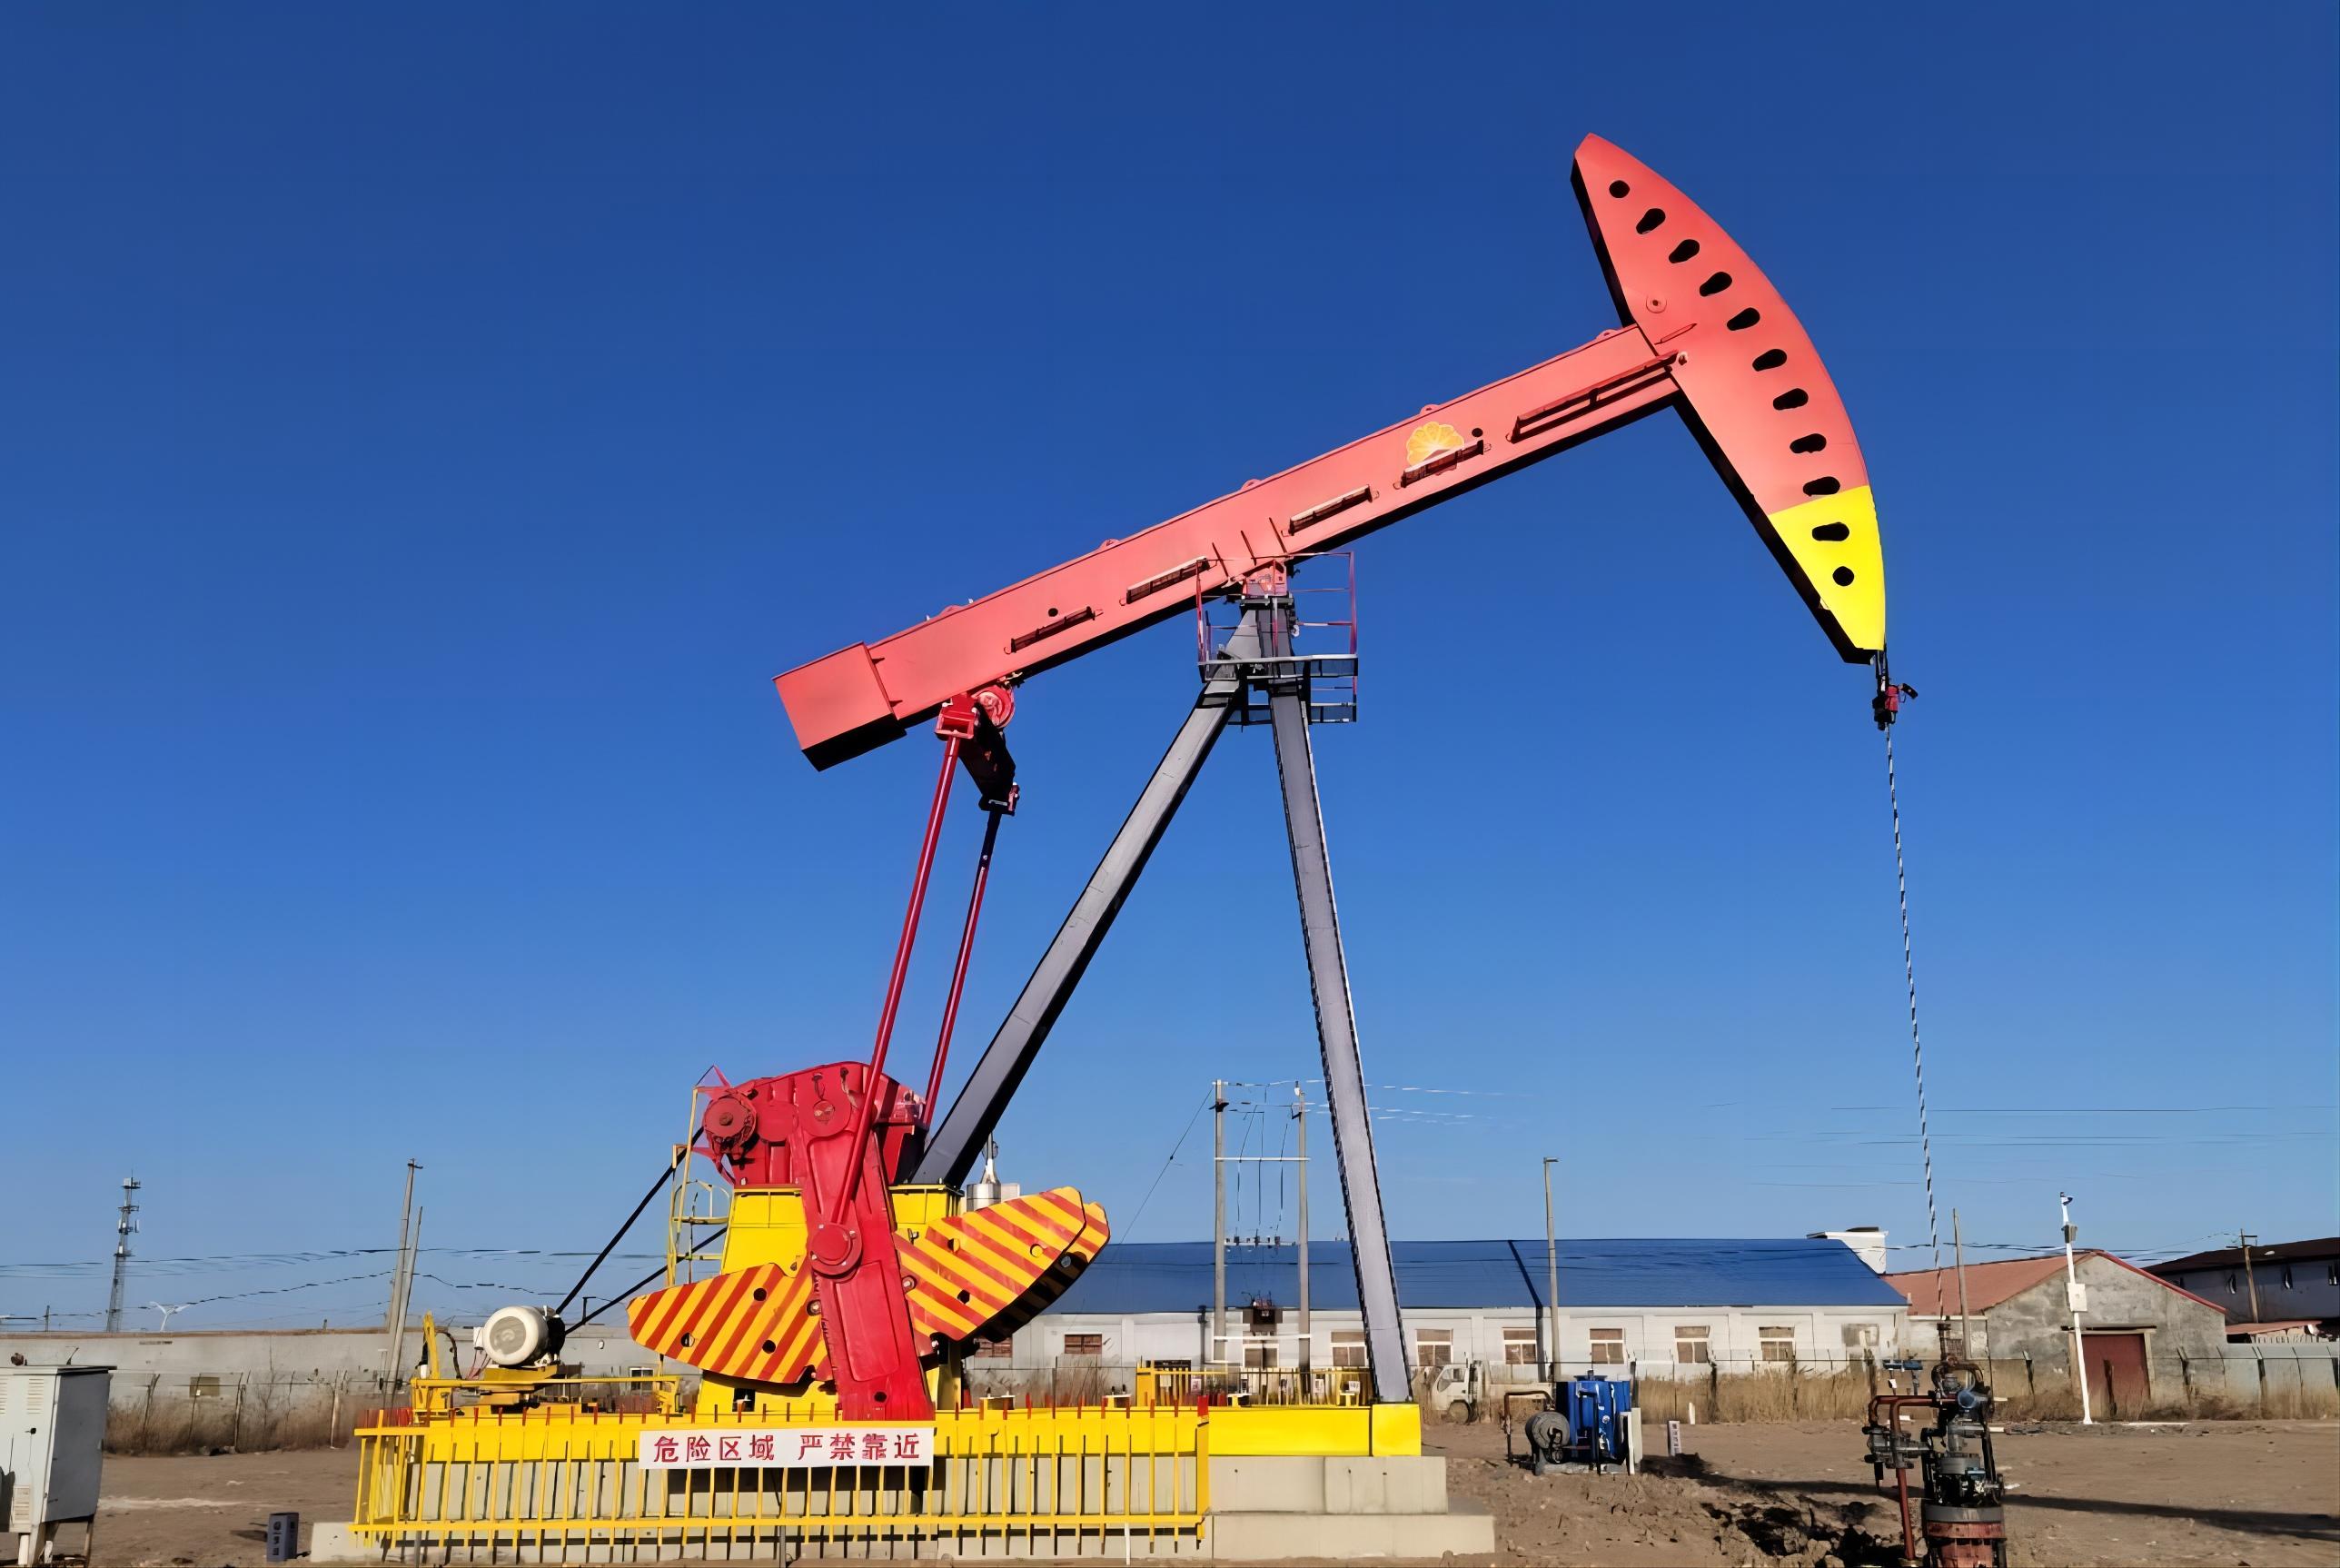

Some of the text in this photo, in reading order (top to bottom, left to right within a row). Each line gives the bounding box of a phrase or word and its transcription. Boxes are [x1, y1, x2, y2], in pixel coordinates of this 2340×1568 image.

[654, 1433, 919, 1463] 危险区域 严禁靠近
